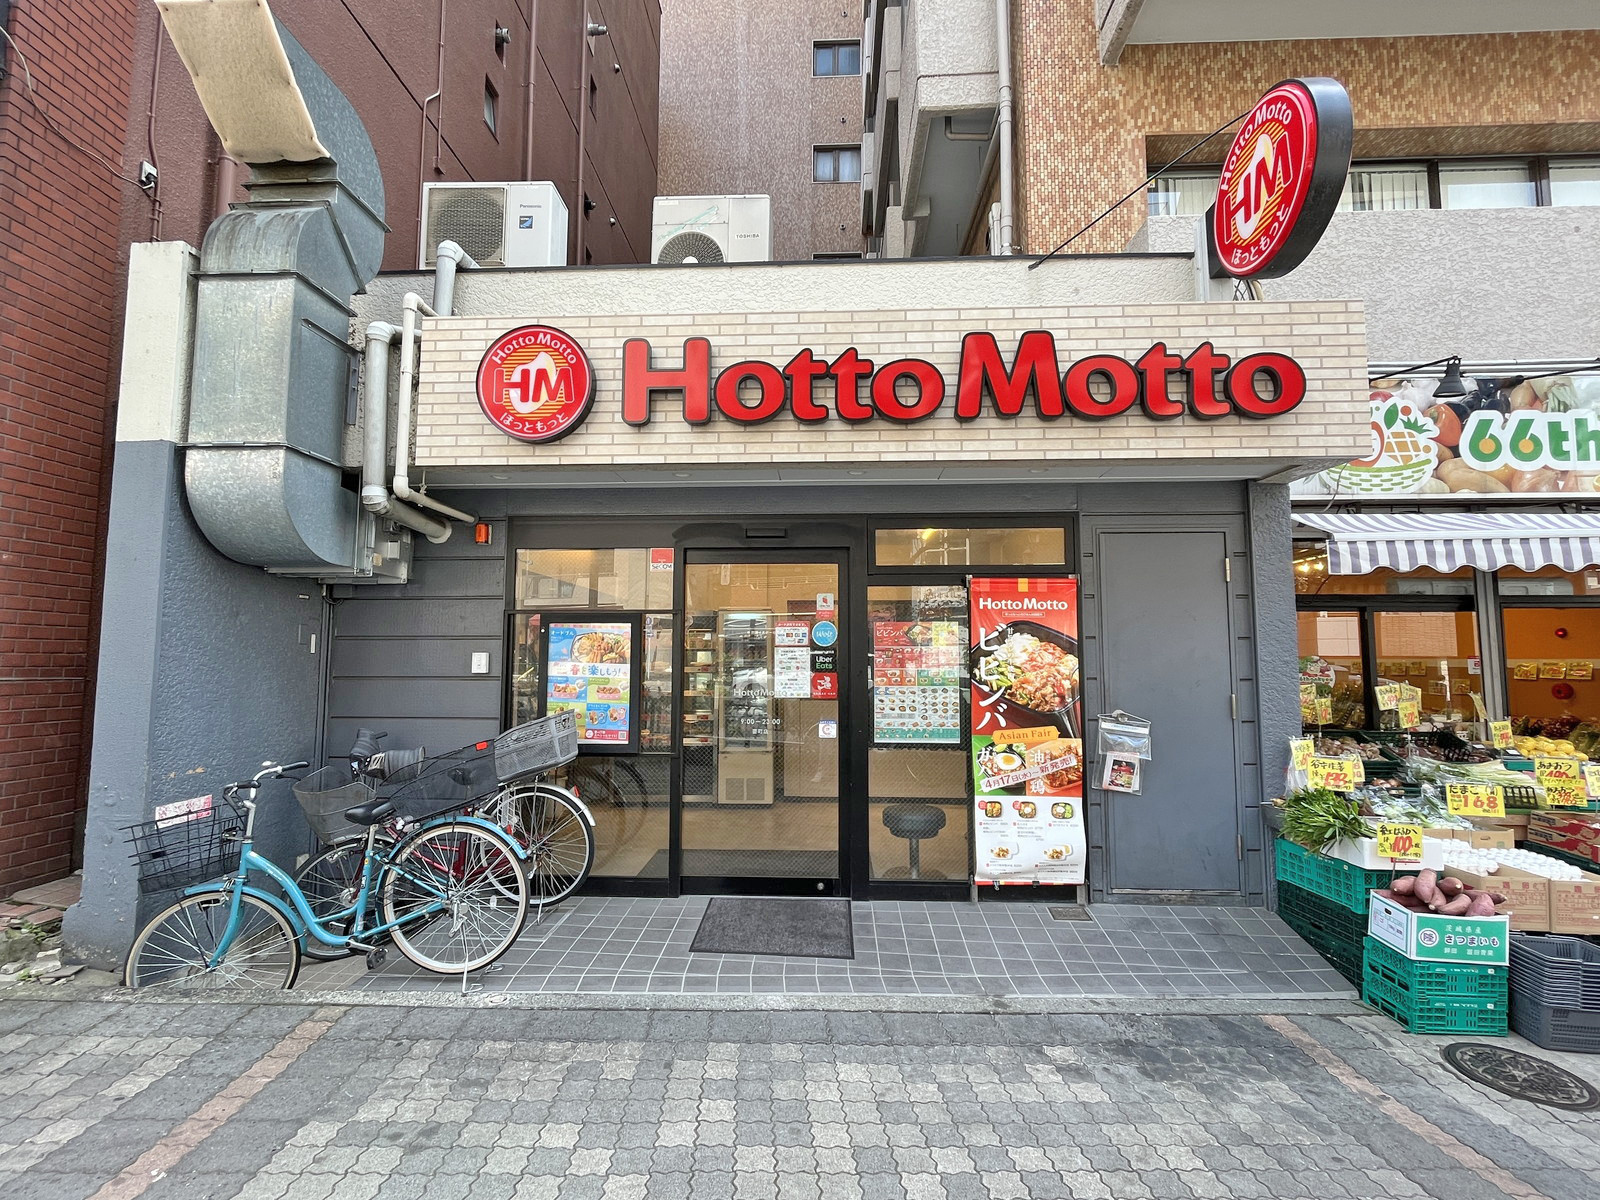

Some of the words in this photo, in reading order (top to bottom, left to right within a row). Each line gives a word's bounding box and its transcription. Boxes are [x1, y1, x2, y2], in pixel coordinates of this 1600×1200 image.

[1219, 122, 1253, 191] Hotto
[1254, 100, 1293, 130] Motto
[1223, 130, 1294, 245] HM
[1230, 203, 1289, 266] ほっともっと
[491, 334, 536, 365] Hotto
[536, 332, 577, 365] Motto
[493, 366, 575, 405] HM
[620, 336, 946, 427] Hotto
[954, 330, 1307, 422] Motto
[499, 411, 569, 434] ほっともっと
[1468, 416, 1600, 463] 66th
[979, 597, 1022, 610] Hotto
[1023, 597, 1069, 610] Motto
[876, 629, 903, 637] ビビンバ
[999, 732, 1028, 740] Asian
[1031, 729, 1051, 738] Fair
[1448, 784, 1479, 795] たまご
[1462, 795, 1498, 809] 168
[1444, 934, 1500, 947] さつまいも
